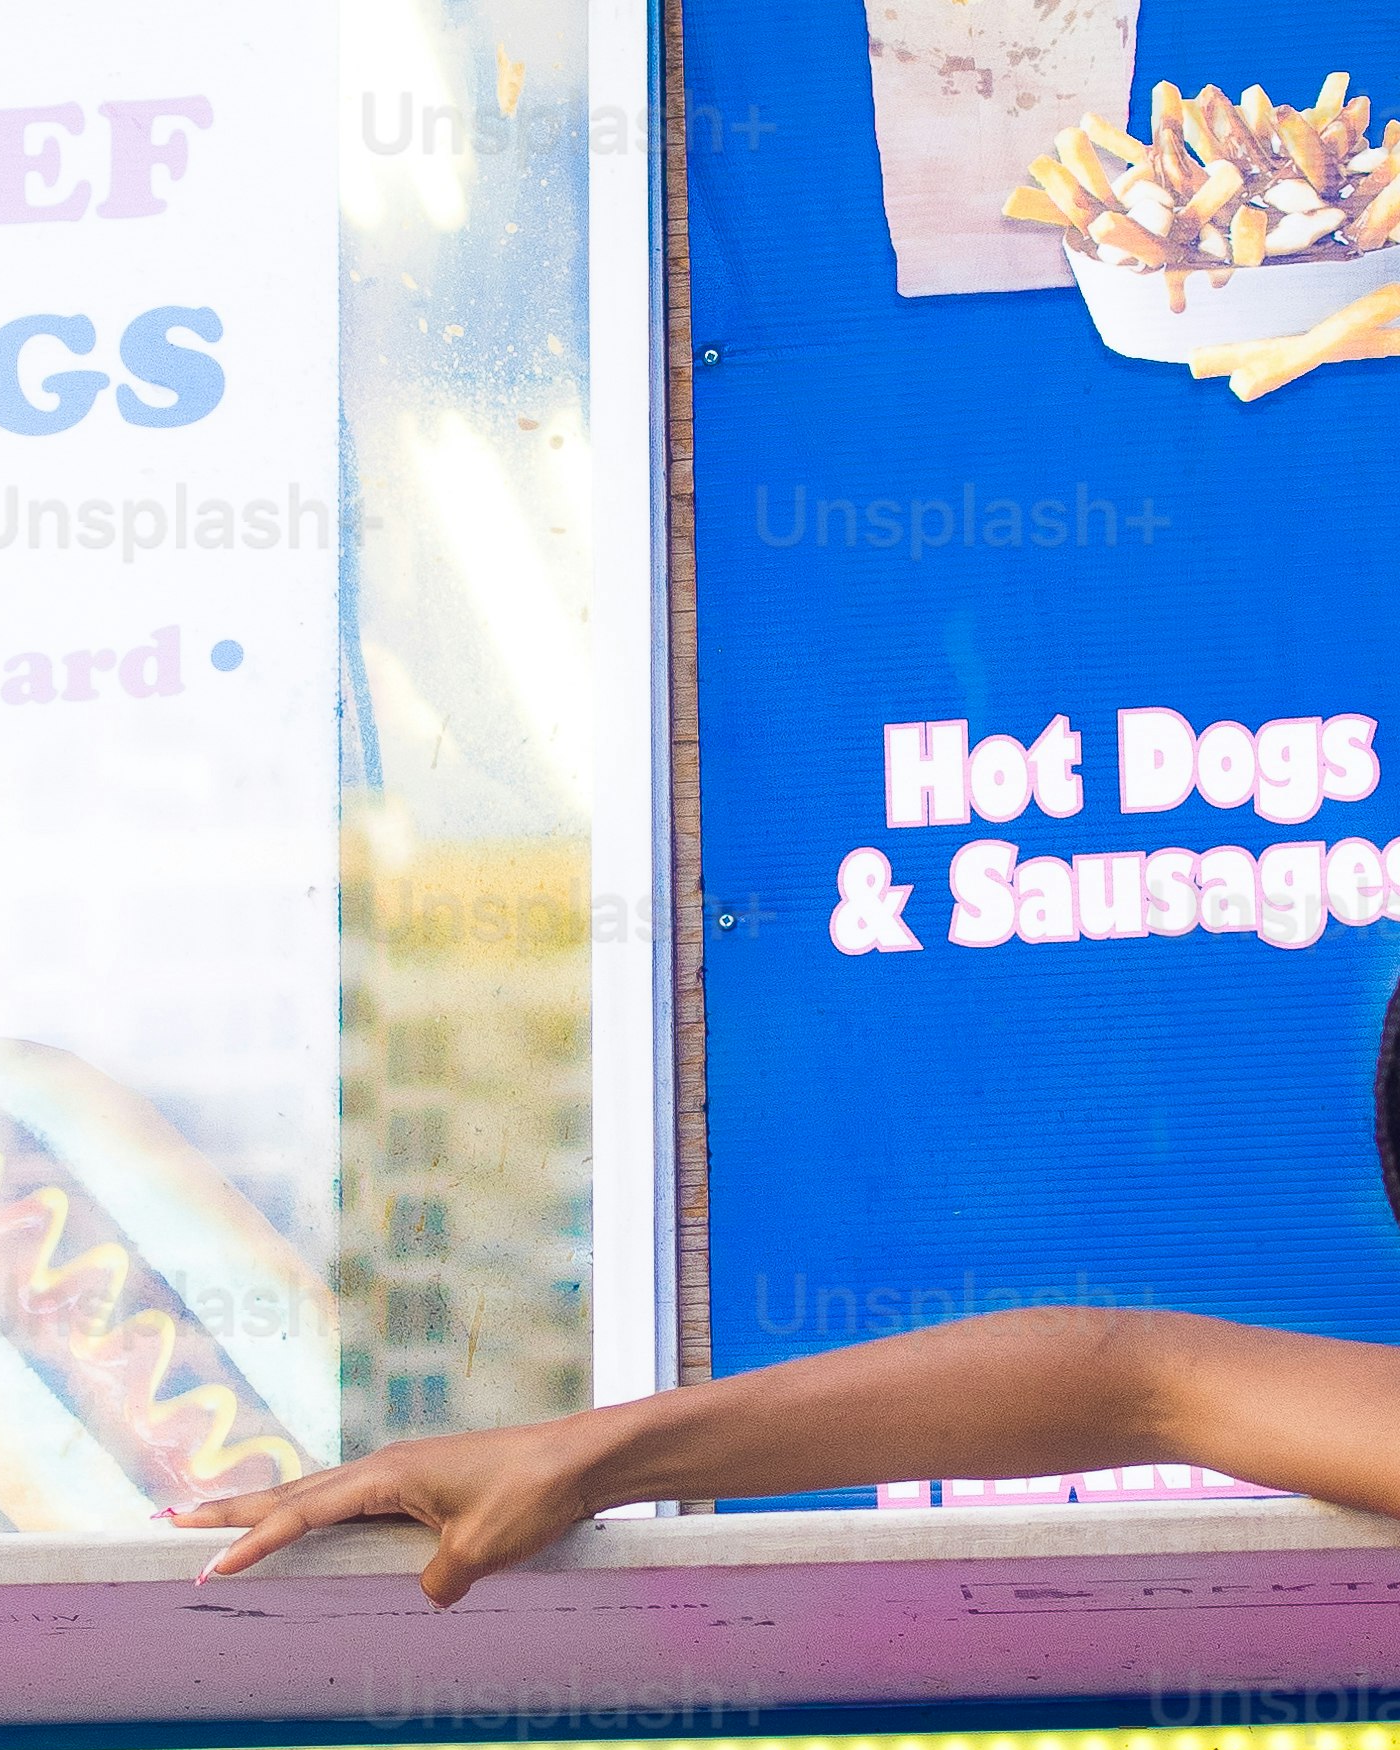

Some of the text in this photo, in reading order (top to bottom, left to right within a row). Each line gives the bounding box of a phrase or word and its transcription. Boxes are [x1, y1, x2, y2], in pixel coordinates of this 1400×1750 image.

[884, 706, 1380, 829] Hot Dogs
[829, 846, 924, 956] &
